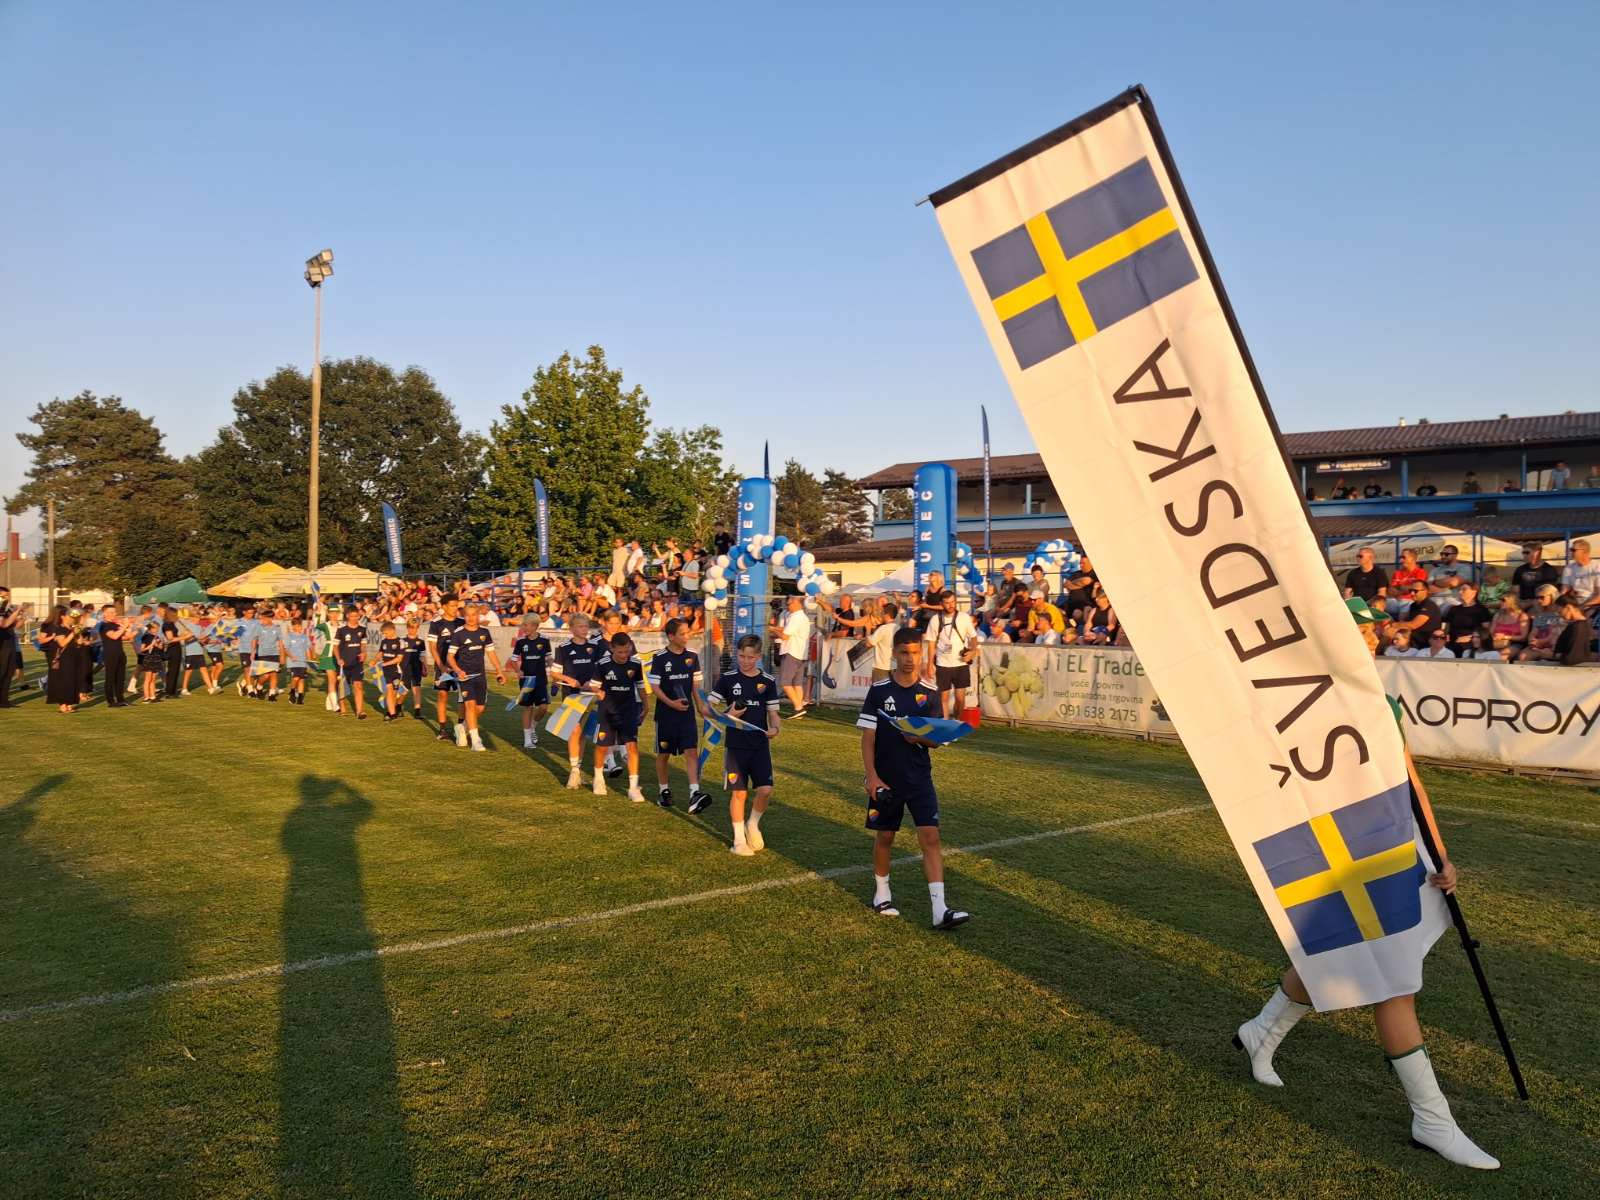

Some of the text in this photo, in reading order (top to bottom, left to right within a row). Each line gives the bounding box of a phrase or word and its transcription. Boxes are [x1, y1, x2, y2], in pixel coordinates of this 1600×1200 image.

[1112, 337, 1370, 788] ŠVEDSKA
[1067, 655, 1087, 673] EL
[1094, 655, 1145, 677] Trade
[884, 703, 896, 711] RA
[1059, 703, 1137, 722] 091 638 2175
[1397, 692, 1600, 737] OPROM
